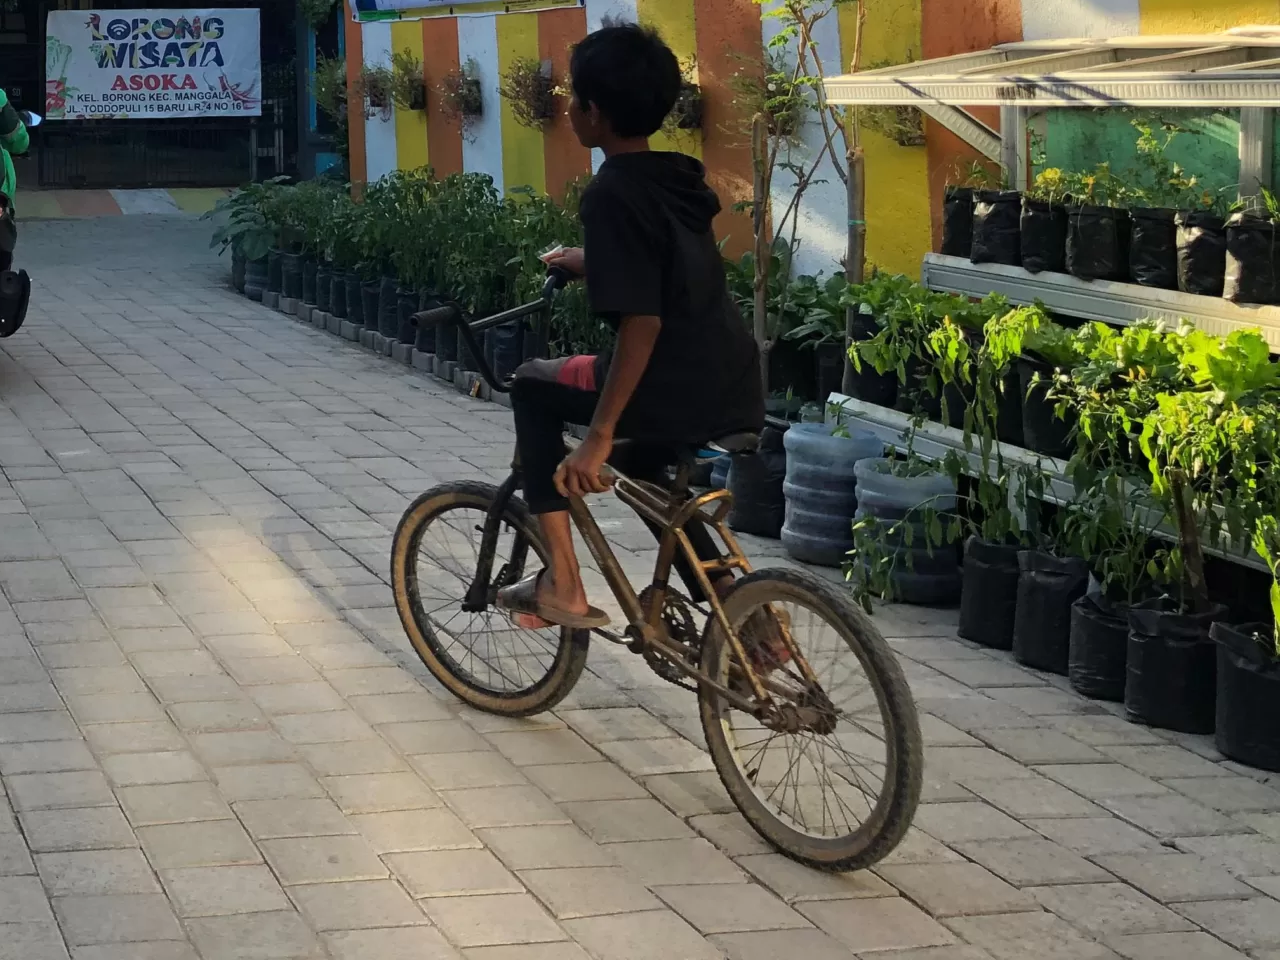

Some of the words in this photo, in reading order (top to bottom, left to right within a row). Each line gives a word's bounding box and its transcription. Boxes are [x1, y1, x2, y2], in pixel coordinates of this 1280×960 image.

[86, 14, 224, 41] LORONG
[91, 41, 224, 69] WISATA
[110, 73, 198, 91] ASOKA
[77, 93, 100, 102] KEL.
[102, 93, 146, 102] BORONG
[148, 92, 172, 101] KEC.
[174, 91, 232, 101] MANGGALA
[66, 105, 81, 113] JL.
[84, 104, 141, 113] TODDOPULI
[143, 104, 154, 113] 15
[157, 103, 185, 112] BARU
[188, 103, 203, 111] LR.
[205, 102, 212, 111] 4
[214, 102, 228, 111] NO
[231, 102, 242, 110] 16
